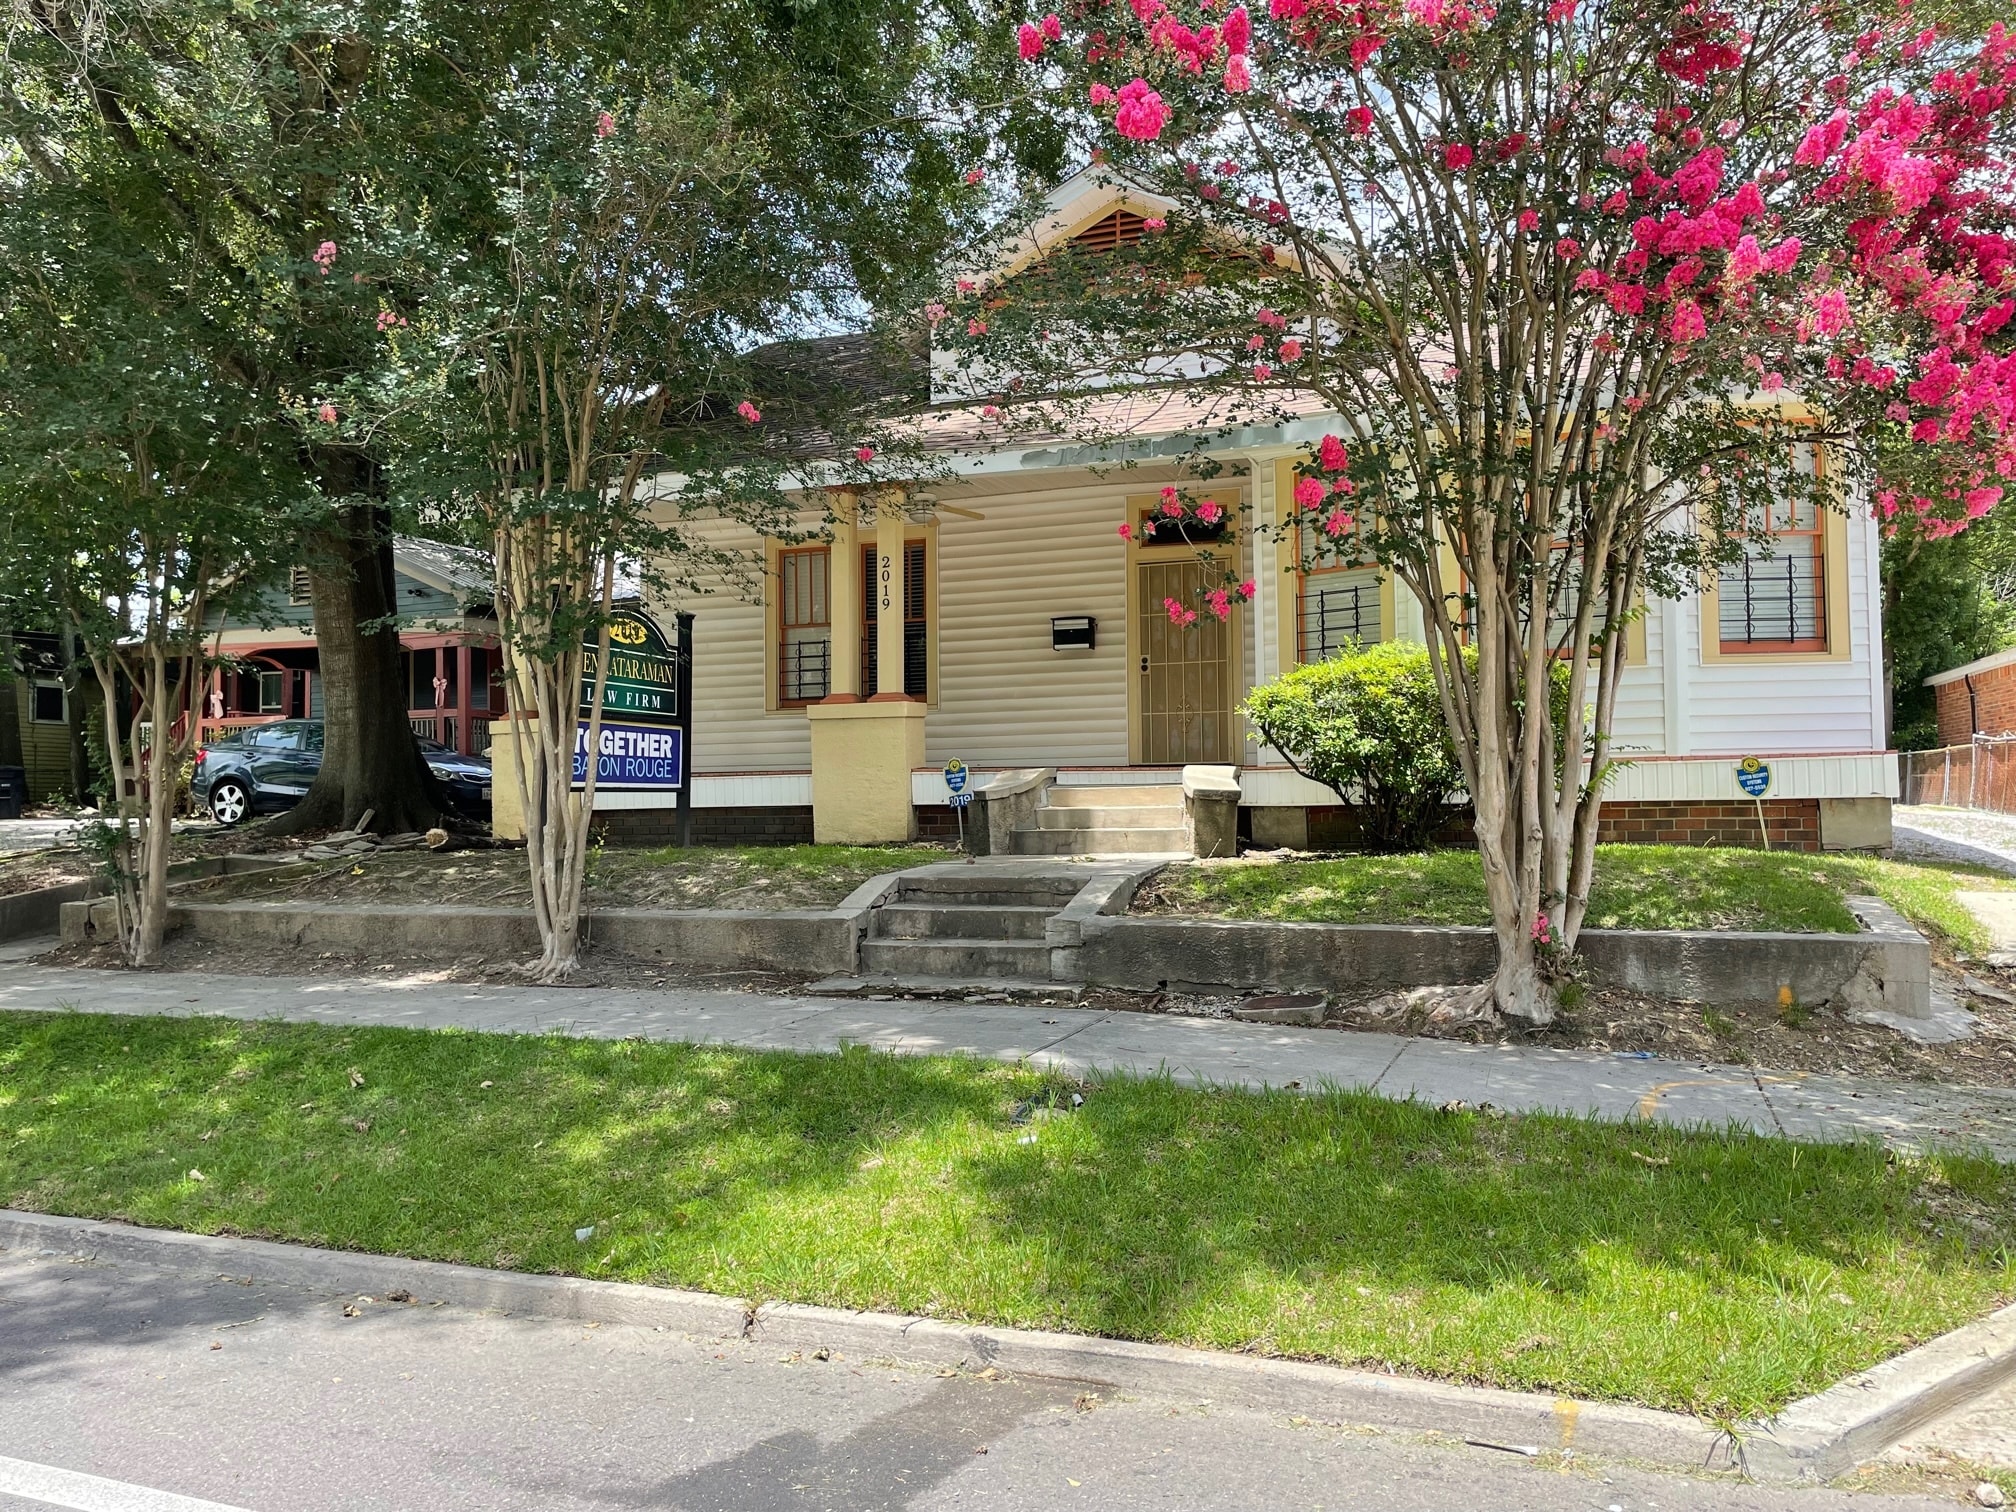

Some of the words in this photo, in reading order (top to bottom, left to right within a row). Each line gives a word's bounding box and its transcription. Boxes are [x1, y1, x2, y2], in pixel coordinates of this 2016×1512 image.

[881, 555, 891, 611] 2019
[582, 651, 673, 684] ENATARAMAN
[586, 687, 618, 704] LW
[625, 692, 661, 709] FIRM
[572, 755, 620, 777] BAON
[625, 757, 673, 778] ROUGE
[949, 794, 972, 808] 2019
